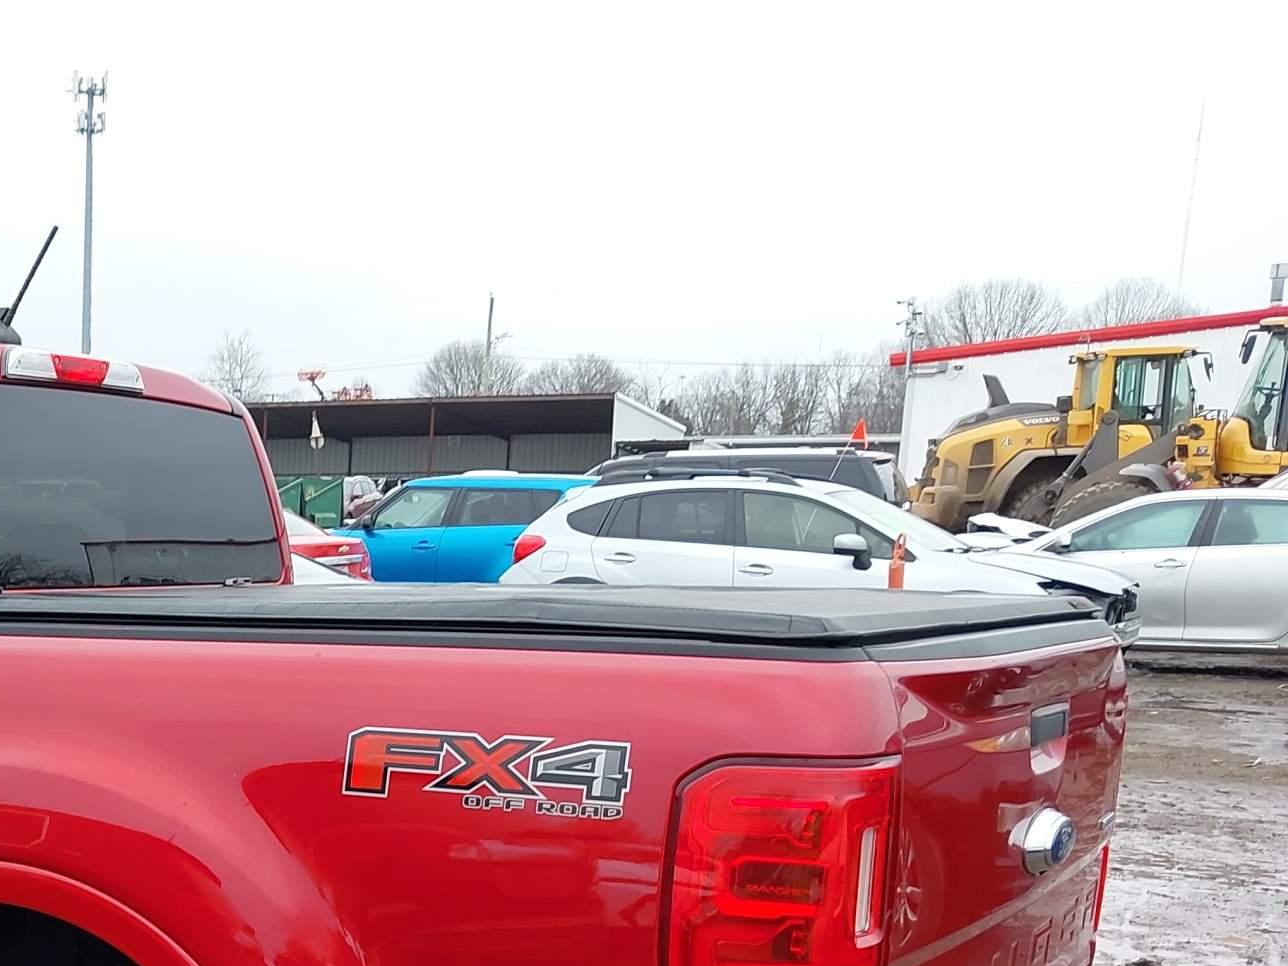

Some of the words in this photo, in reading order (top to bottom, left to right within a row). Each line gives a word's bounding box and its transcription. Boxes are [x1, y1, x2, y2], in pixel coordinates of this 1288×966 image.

[1023, 416, 1060, 425] VOLVO
[342, 726, 631, 805] FX4
[462, 795, 525, 812] OFF
[536, 801, 623, 820] ROAD
